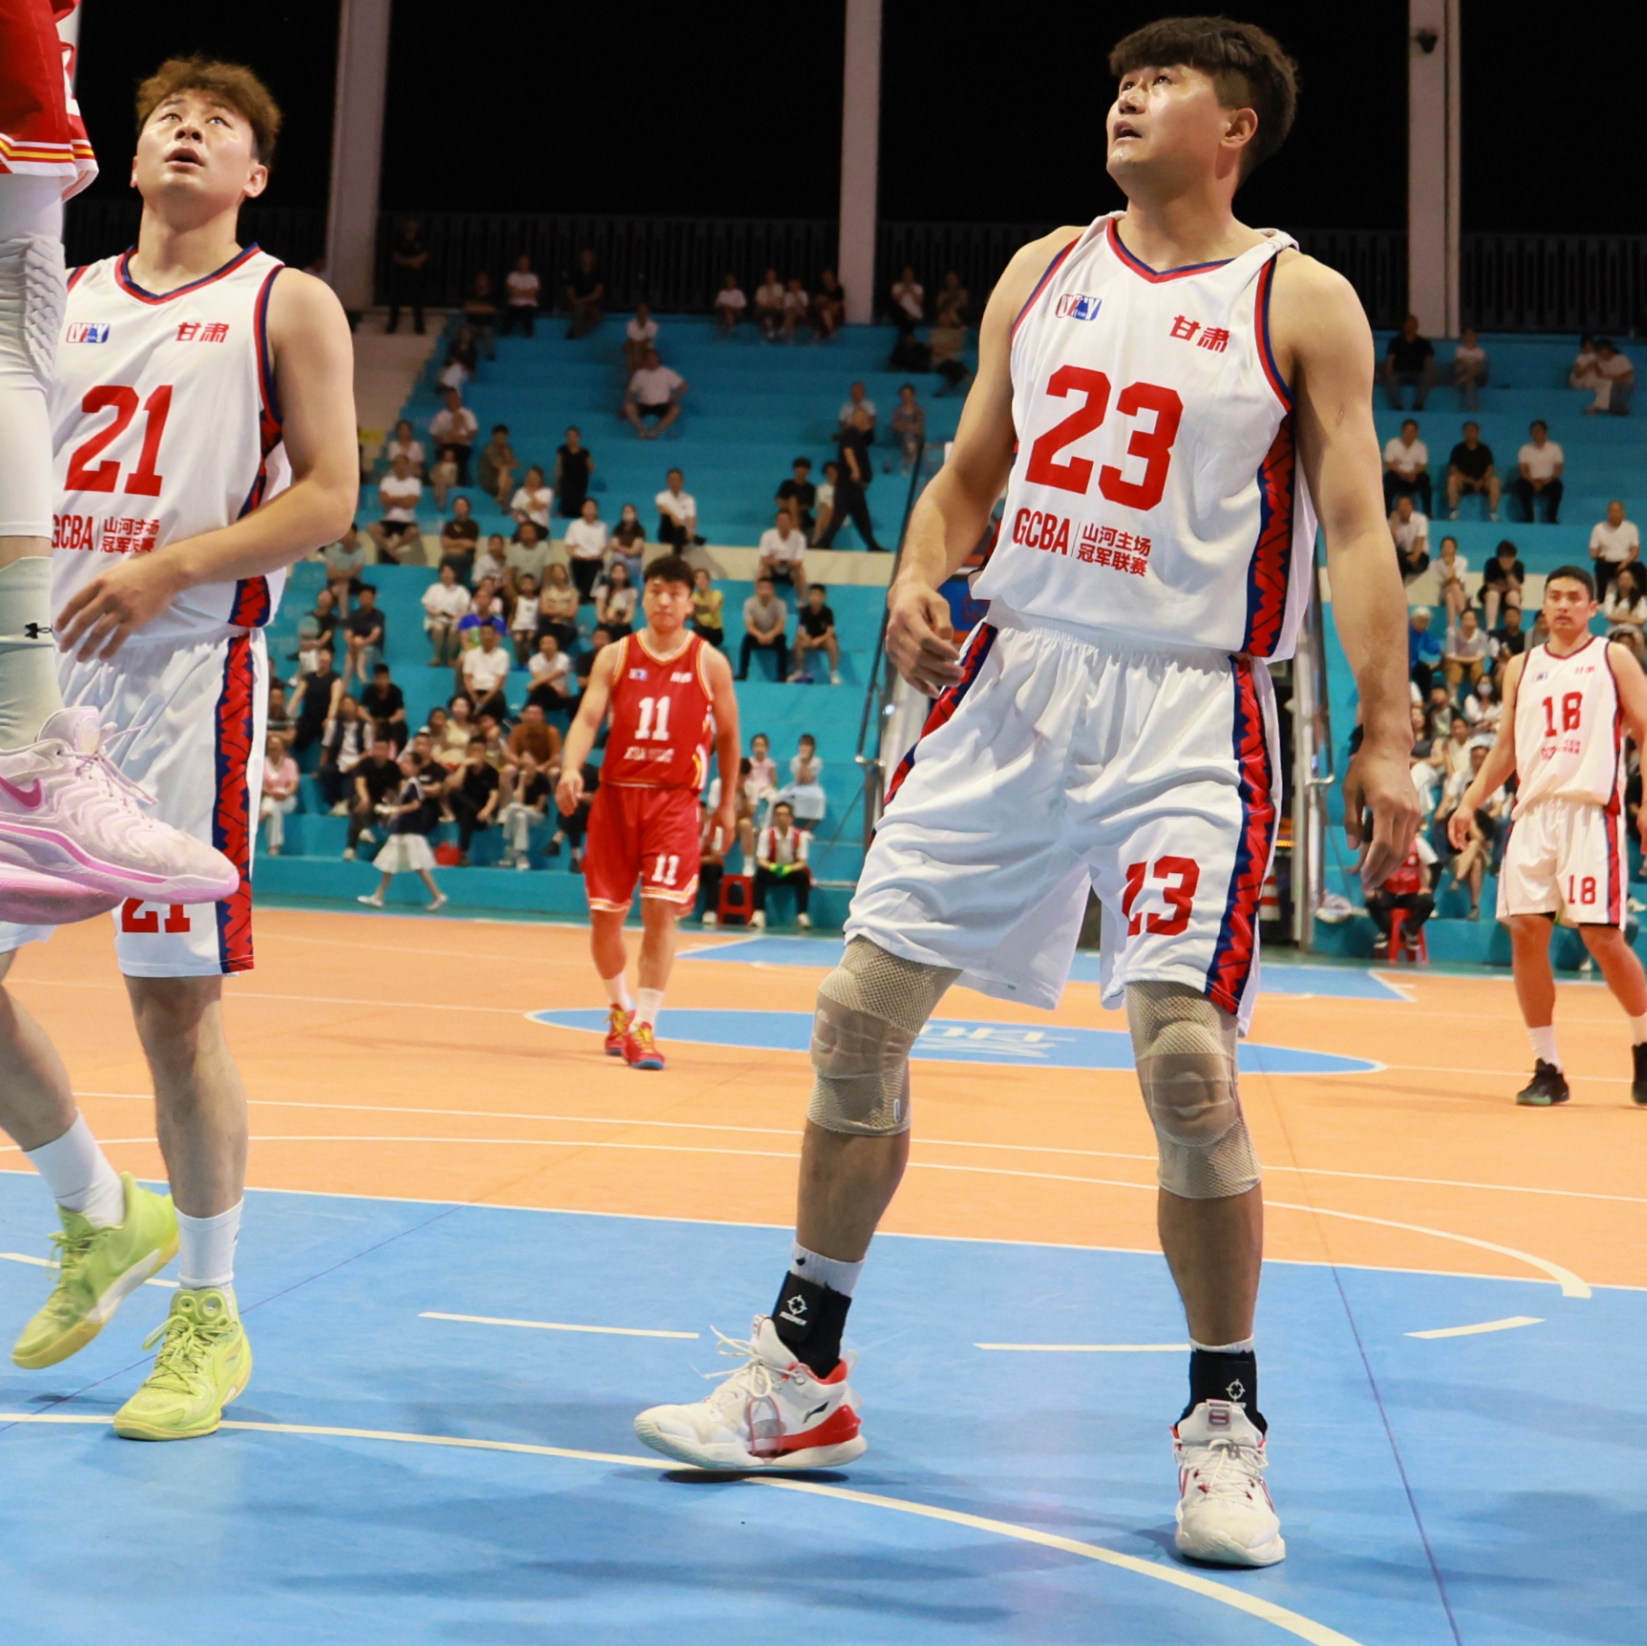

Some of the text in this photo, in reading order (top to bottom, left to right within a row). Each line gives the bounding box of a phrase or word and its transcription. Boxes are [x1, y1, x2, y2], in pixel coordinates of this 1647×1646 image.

[176, 322, 230, 343] 甘肃
[1169, 315, 1230, 353] 甘肃
[64, 385, 173, 497] 21
[1025, 364, 1184, 512] 23
[52, 514, 93, 550] GCBA
[1012, 508, 1070, 556] GCBA
[1082, 523, 1151, 557] 山河主场
[1077, 542, 1148, 577] 冠军联赛
[635, 696, 671, 741] 11
[1542, 691, 1583, 738] 18
[652, 854, 680, 885] 11
[1567, 875, 1596, 905] 18
